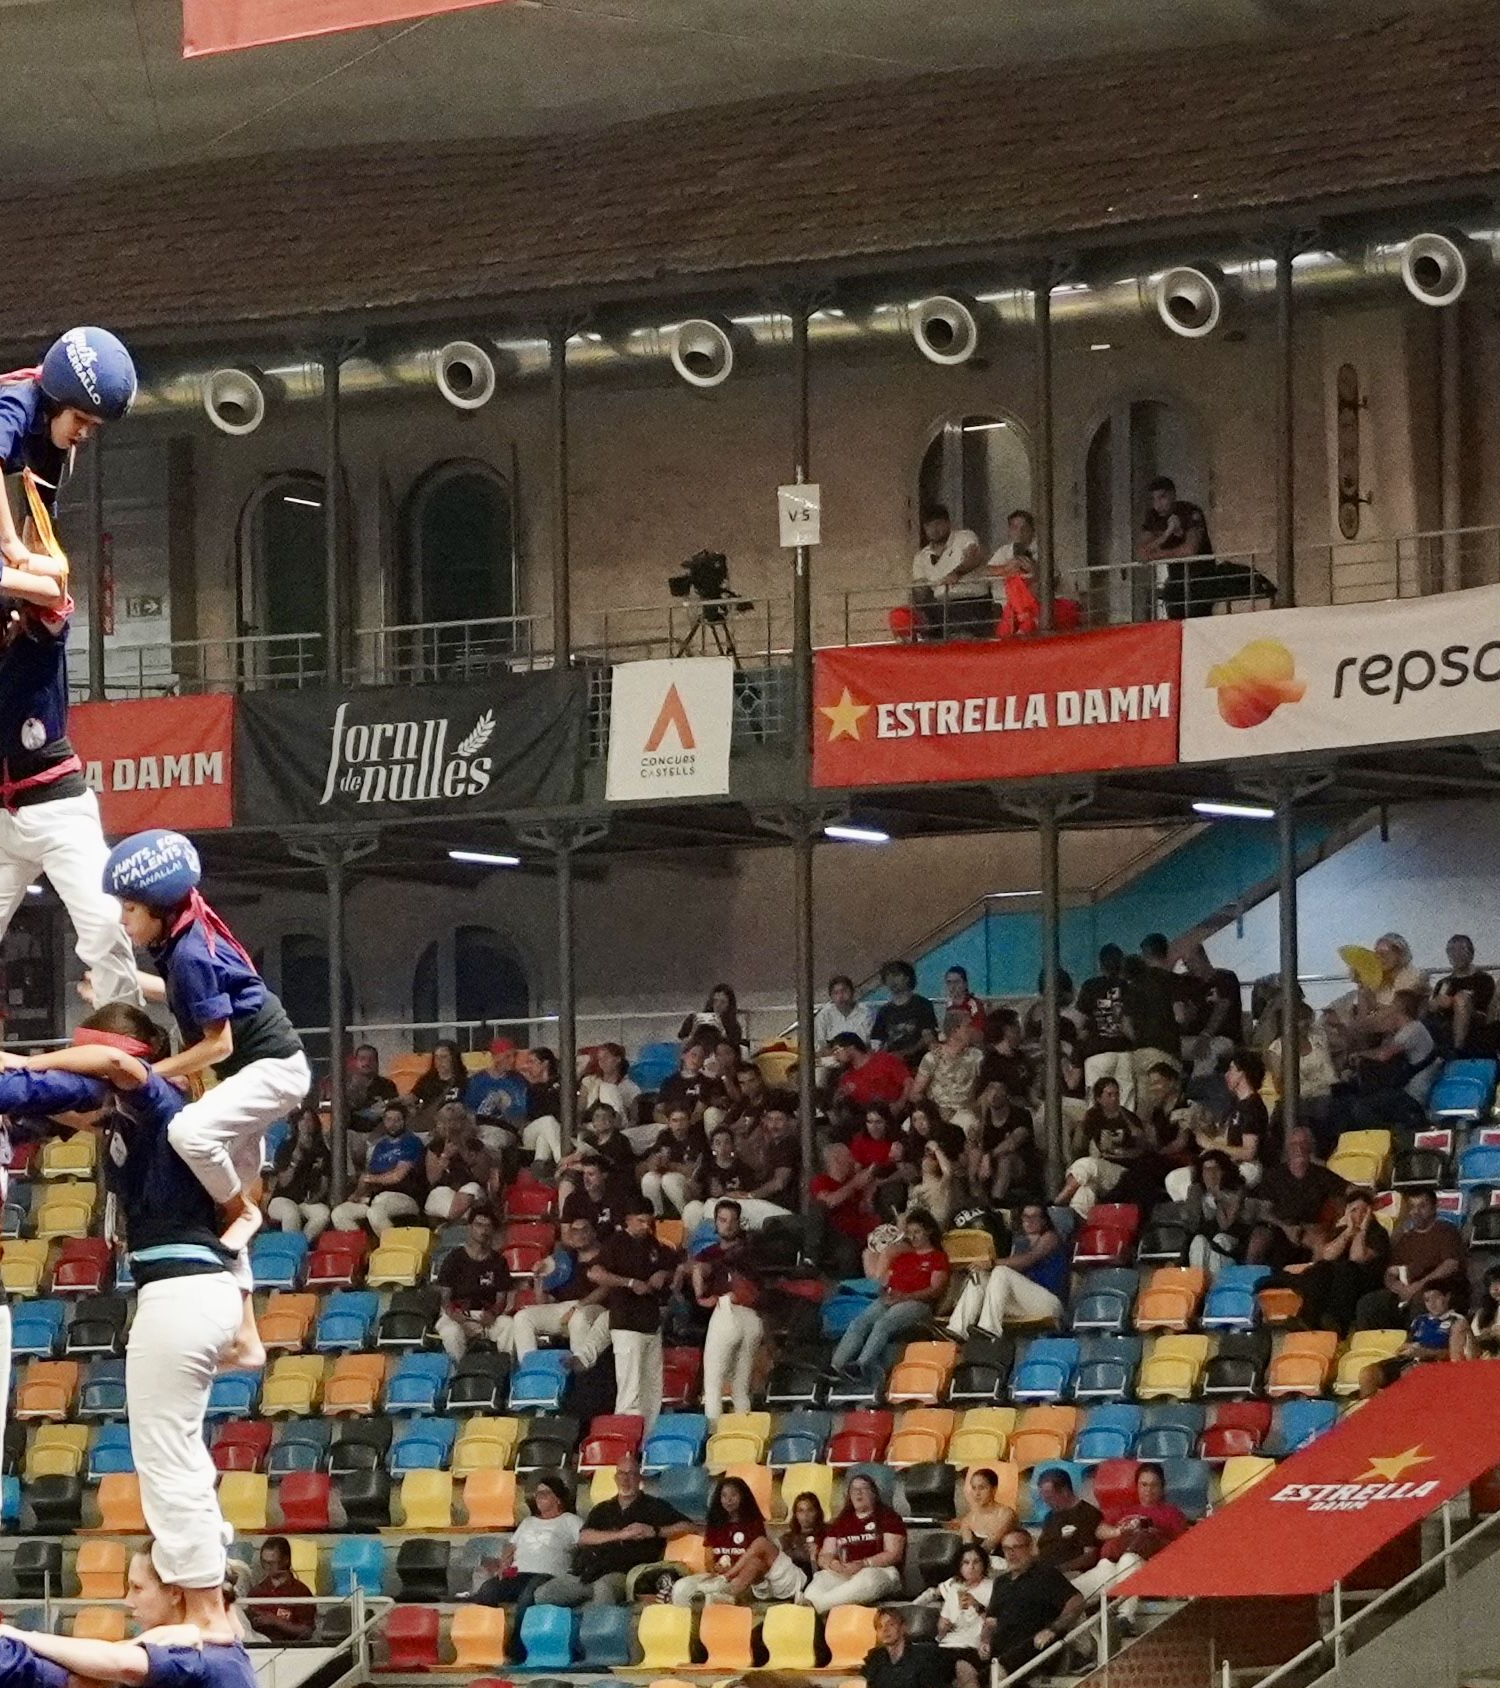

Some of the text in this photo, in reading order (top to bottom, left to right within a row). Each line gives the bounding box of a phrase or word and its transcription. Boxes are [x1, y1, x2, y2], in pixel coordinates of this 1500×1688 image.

[65, 344, 102, 406] SERRALLO
[877, 682, 1172, 740] ESTRELLA DAMM
[111, 751, 224, 792] DAMM
[639, 766, 696, 778] CASTELLS
[640, 755, 696, 767] CONCURS
[121, 846, 183, 885] VALENTS
[1271, 1480, 1440, 1502] ESTRELLA
[1308, 1500, 1369, 1511] DAMM
